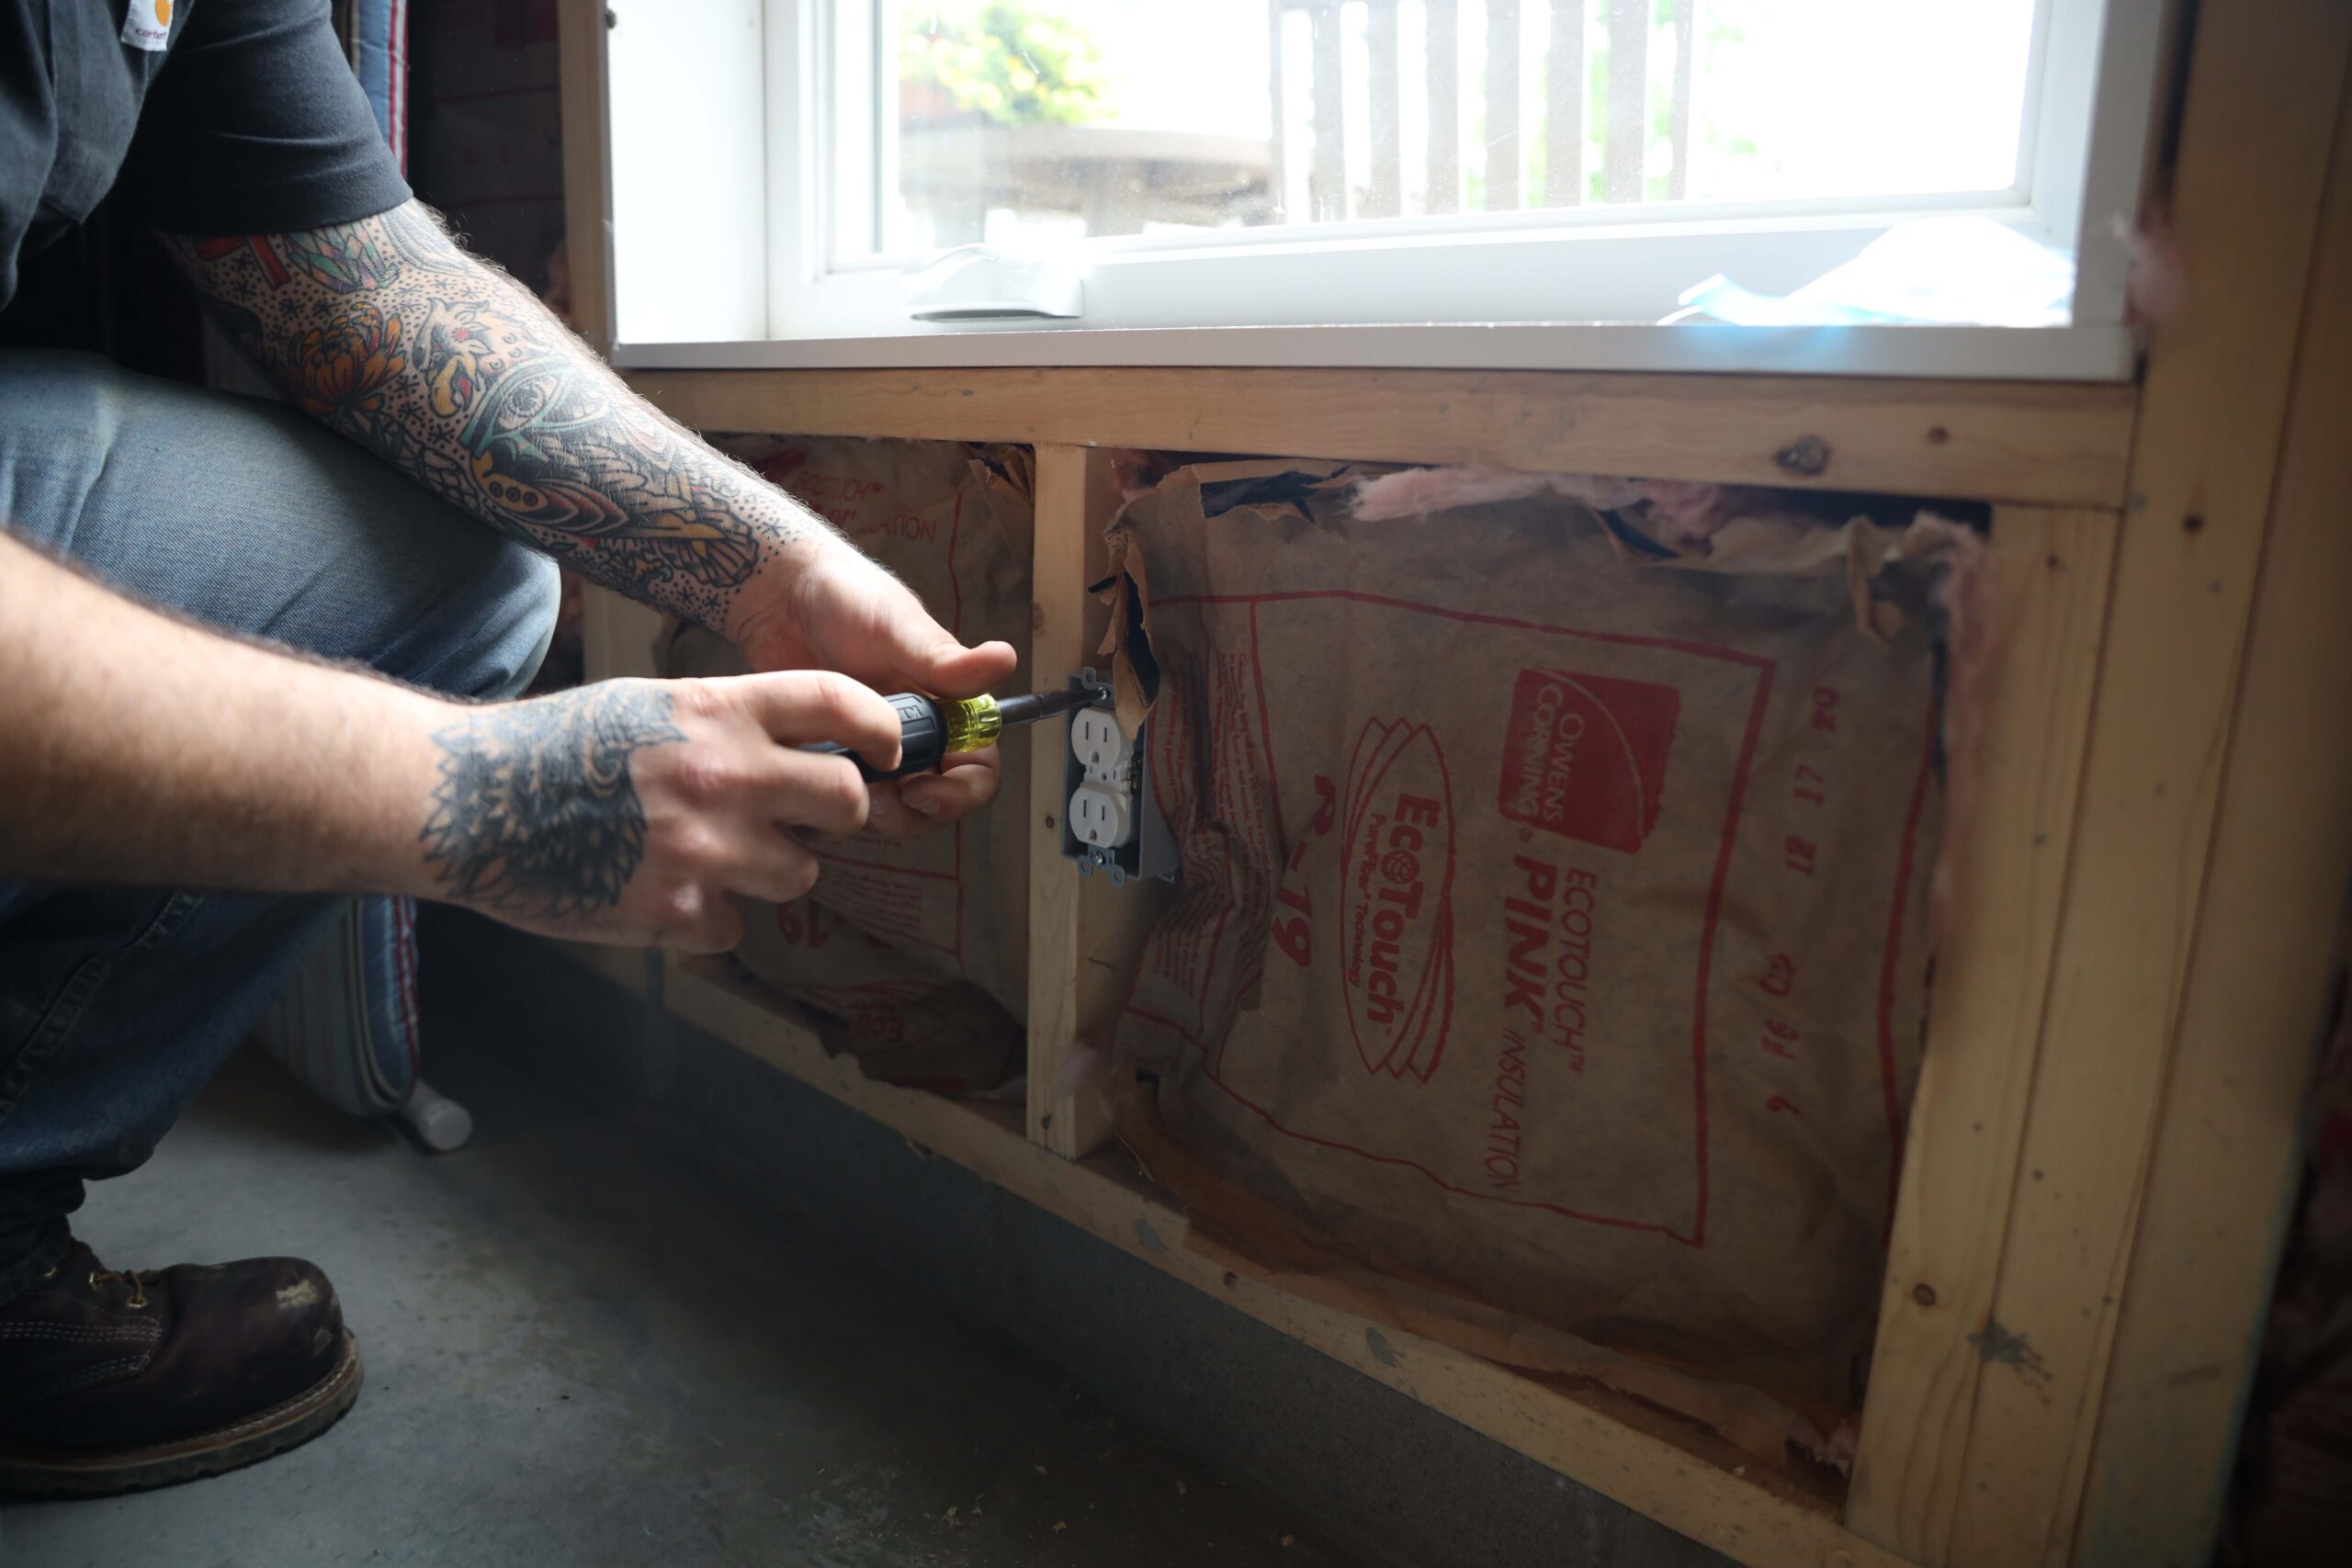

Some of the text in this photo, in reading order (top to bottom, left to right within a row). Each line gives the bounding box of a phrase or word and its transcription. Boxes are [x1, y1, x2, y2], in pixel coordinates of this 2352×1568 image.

[1519, 682, 1564, 818] CORNING
[1543, 712, 1585, 823] OWENS
[1792, 763, 1826, 807] 17
[1348, 902, 1369, 989] Technology
[1484, 1027, 1527, 1195] INSULATION
